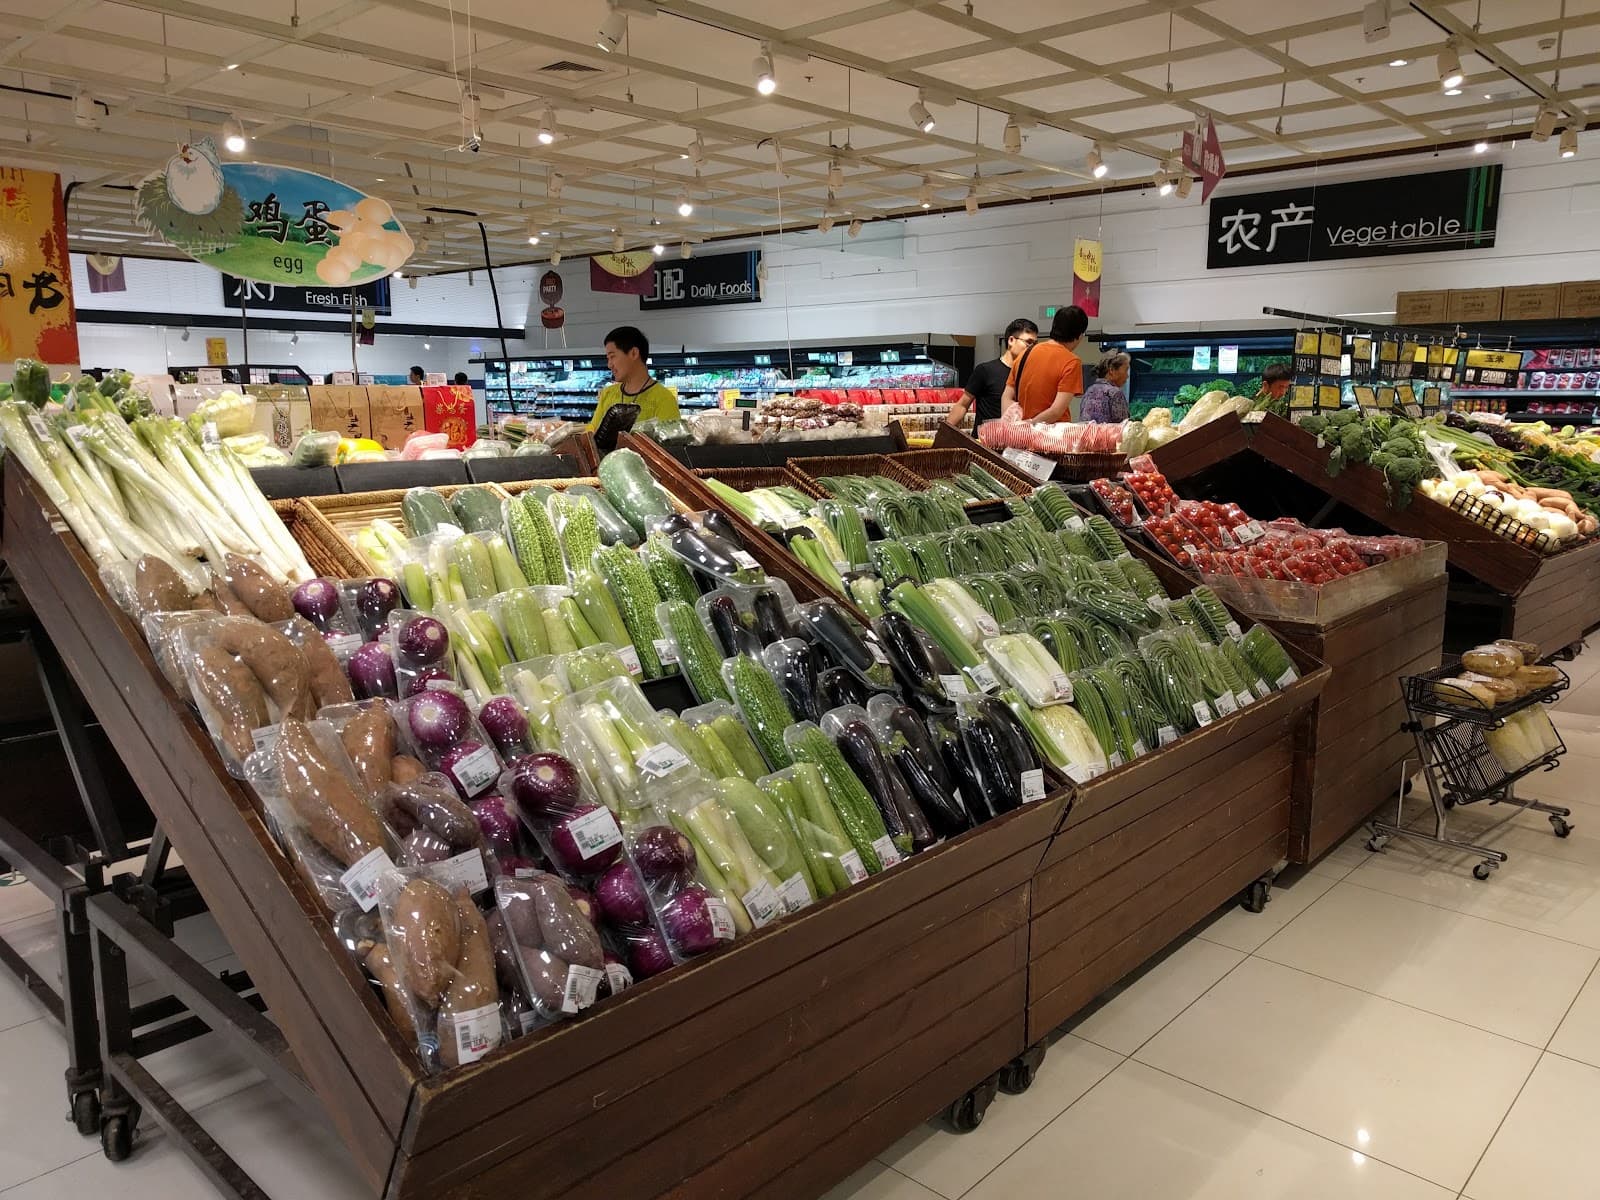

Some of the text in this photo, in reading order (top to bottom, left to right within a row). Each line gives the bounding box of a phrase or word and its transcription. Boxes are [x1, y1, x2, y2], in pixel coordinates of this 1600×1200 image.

[244, 193, 343, 247] 鸡蛋
[1218, 203, 1315, 254] 农产
[1326, 216, 1461, 247] Vegetable
[273, 256, 303, 274] egg
[305, 291, 368, 306] Fresh Fish
[691, 280, 752, 298] Daily Foods
